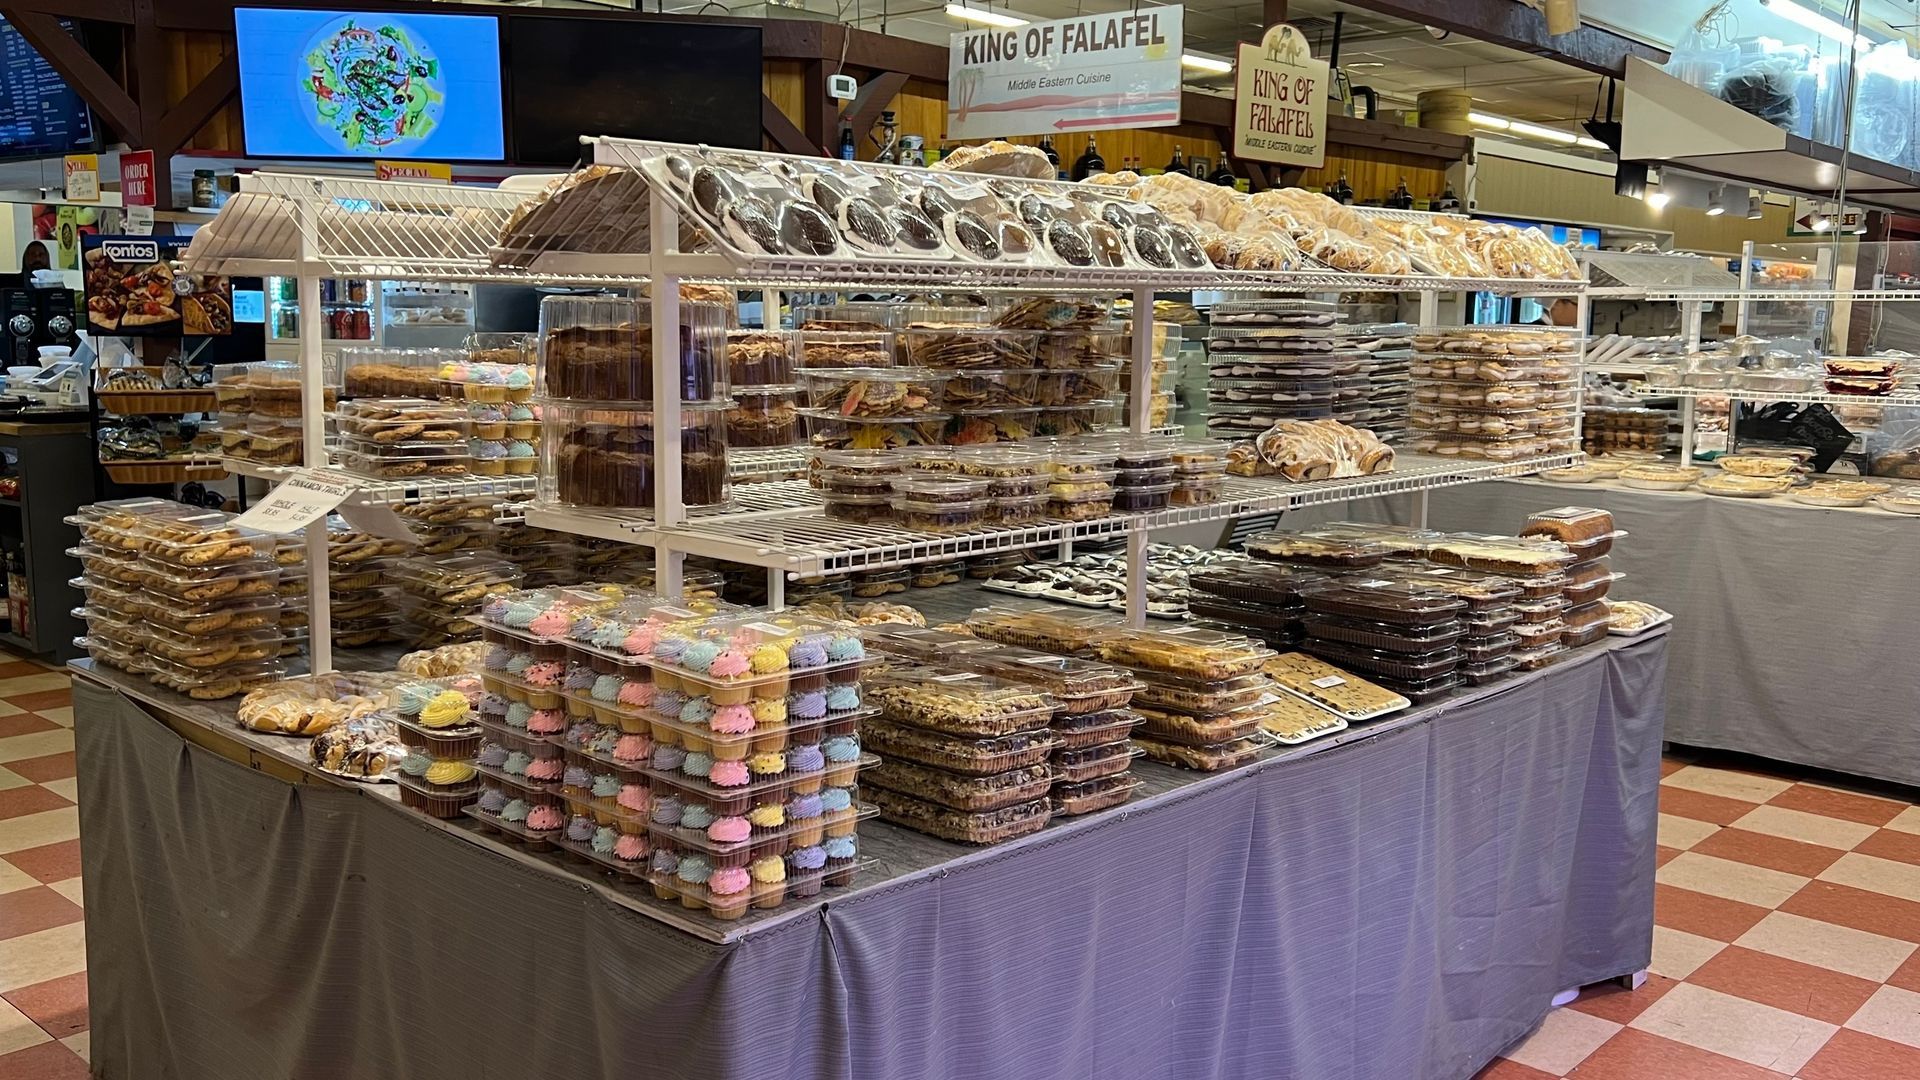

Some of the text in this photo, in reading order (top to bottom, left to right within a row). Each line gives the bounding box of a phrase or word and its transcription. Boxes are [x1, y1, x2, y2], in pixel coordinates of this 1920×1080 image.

[963, 14, 1165, 65] KING OF FALAFEL
[1007, 72, 1112, 91] Middle Eastern Cuisine
[1253, 68, 1315, 105] KING OF
[1249, 102, 1314, 138] FALAFEL
[1267, 140, 1293, 152] EASTERN
[124, 163, 149, 180] ORDER
[128, 181, 146, 197] HERE
[102, 244, 154, 258] kontos
[288, 479, 346, 497] CINNAMON TWIRLS
